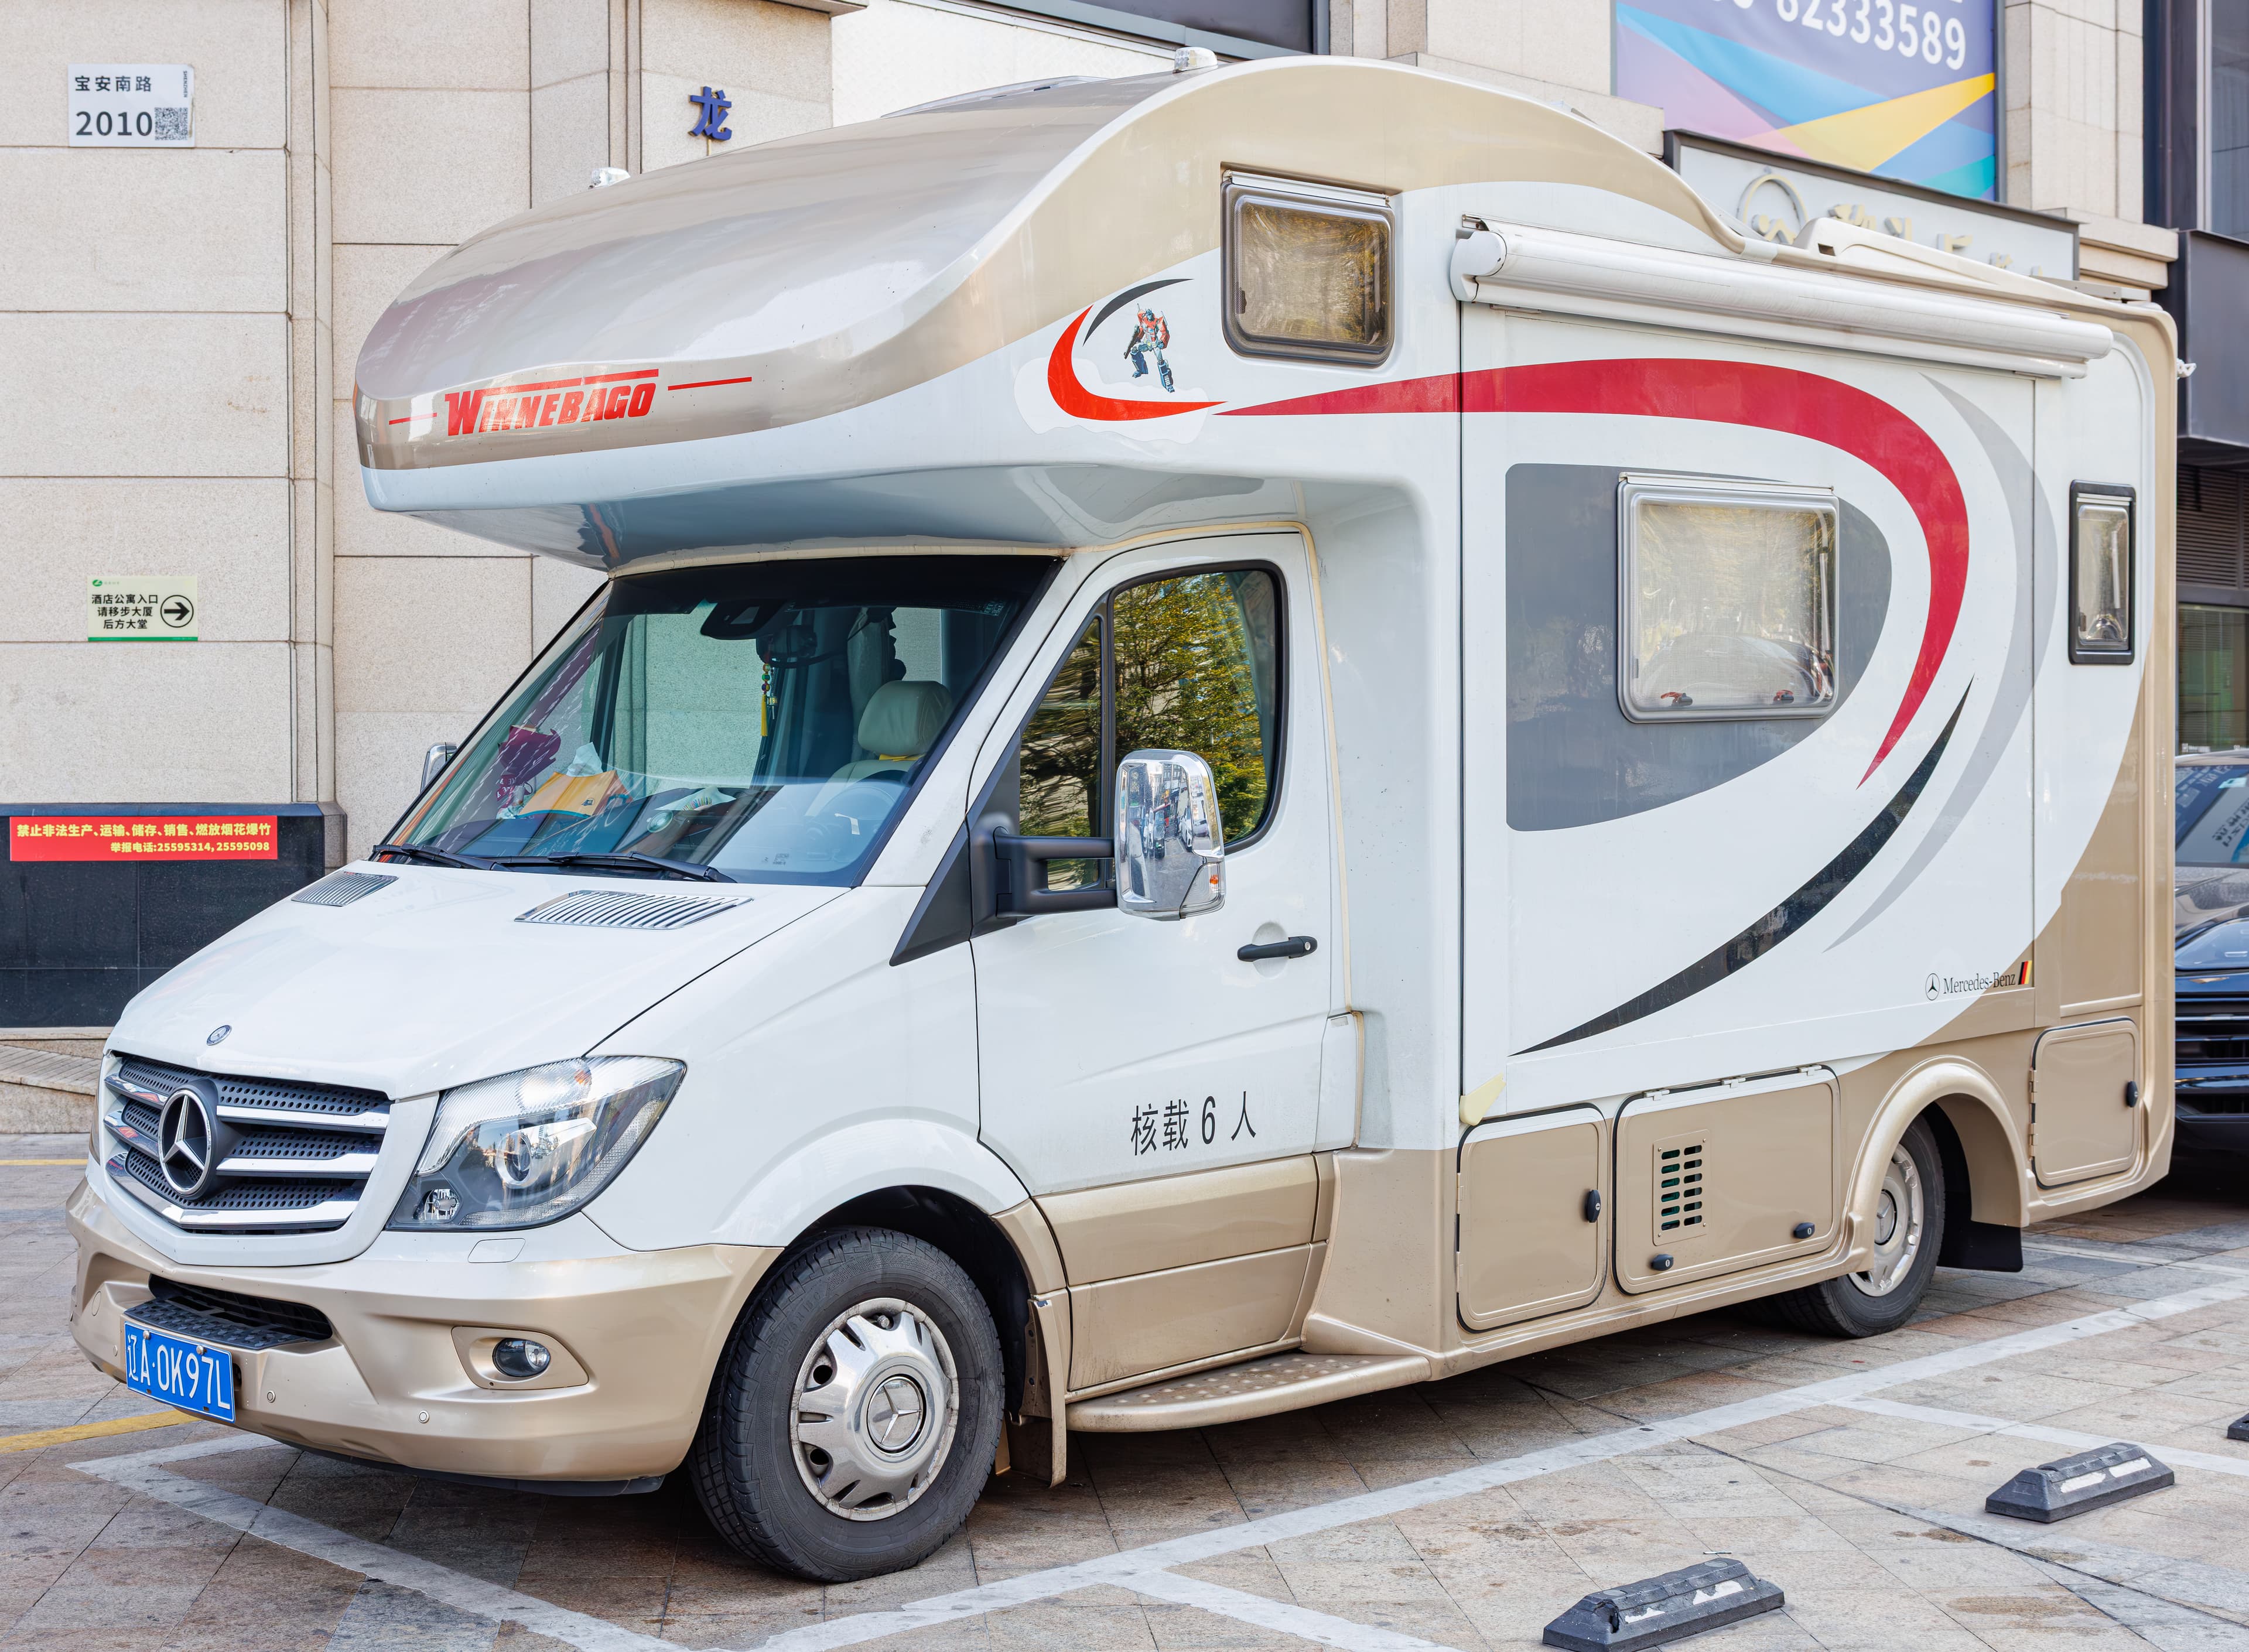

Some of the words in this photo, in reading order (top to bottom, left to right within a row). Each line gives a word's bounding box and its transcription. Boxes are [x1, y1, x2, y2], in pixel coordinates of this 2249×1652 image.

[75, 76, 152, 92] 宝安南路
[689, 85, 733, 141] 龙
[76, 111, 153, 136] 2010
[445, 382, 657, 437] WINNEBAGO
[91, 594, 158, 604] 酒店公寓入口
[97, 607, 153, 617] 请移步大厦
[103, 619, 148, 630] 后方大堂
[17, 823, 271, 837] 禁止非法生产、运输、储存、销售、燃放烟花爆竹
[1943, 972, 2016, 994] Mercedes-Benz
